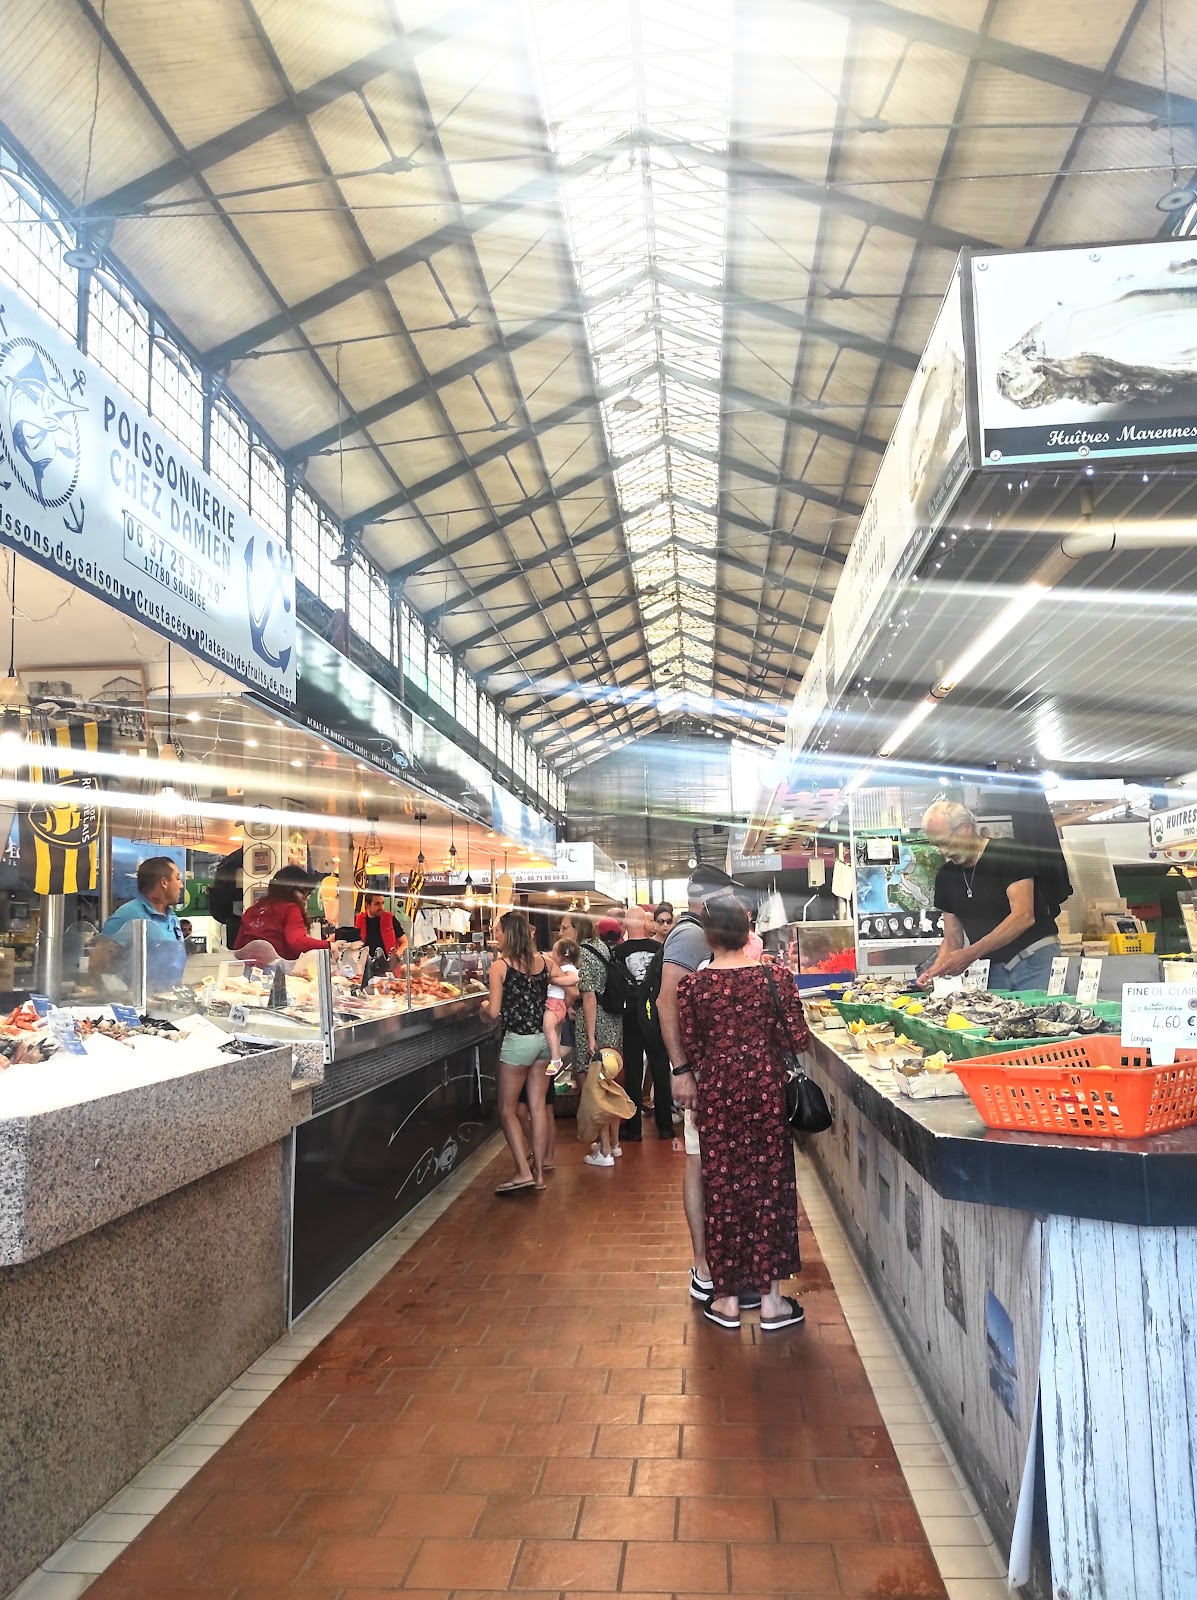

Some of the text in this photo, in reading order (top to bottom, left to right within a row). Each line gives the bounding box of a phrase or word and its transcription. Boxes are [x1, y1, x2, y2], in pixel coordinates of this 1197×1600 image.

[1047, 425, 1197, 447] Huîtres Marennes
[104, 395, 235, 543] POISSONNERIE
[109, 448, 231, 575] CHEZ DAMIEN
[126, 516, 144, 548] 06
[149, 533, 165, 563] 37
[170, 549, 185, 578] 29
[144, 556, 207, 612] 17780 SOUBISE
[56, 541, 72, 566] de
[78, 557, 119, 597] saison
[137, 589, 188, 638] Crustacés
[200, 628, 236, 666] Plateaux
[236, 656, 246, 673] de
[247, 660, 268, 684] fruits
[269, 675, 278, 692] de
[279, 682, 293, 701] mer
[307, 716, 323, 732] ACHAT
[1166, 808, 1197, 829] HUITRES
[1127, 987, 1149, 996] FINE
[1151, 987, 1162, 996] DE
